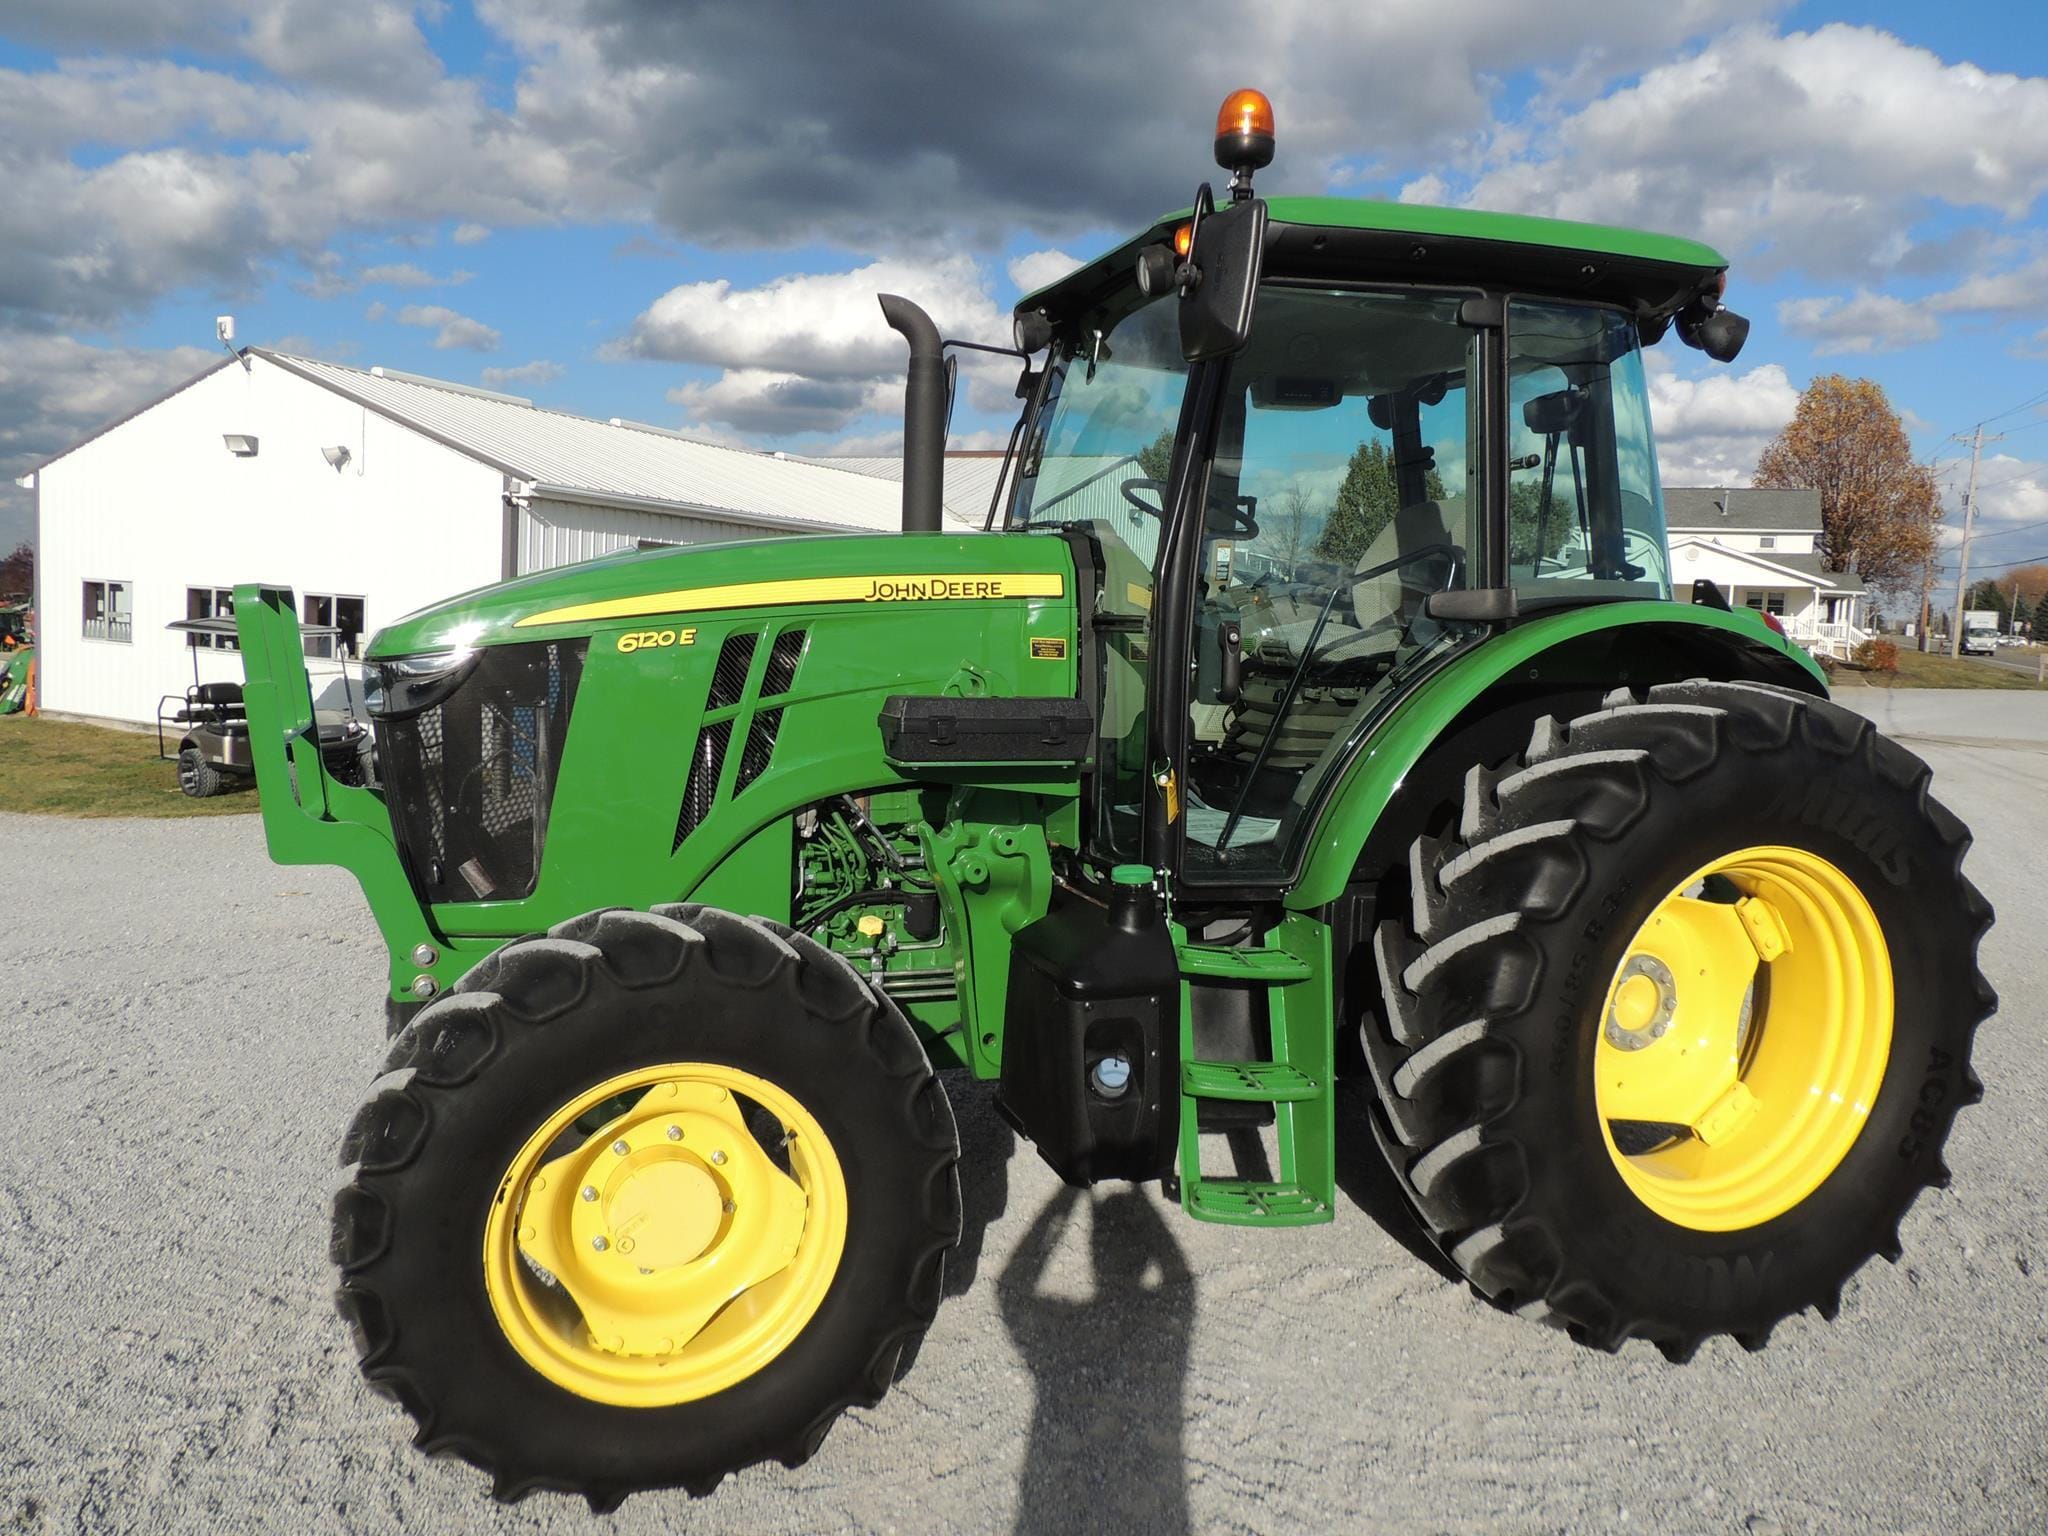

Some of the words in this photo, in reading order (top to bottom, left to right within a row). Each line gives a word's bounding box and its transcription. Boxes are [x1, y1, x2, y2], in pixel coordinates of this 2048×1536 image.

[864, 580, 927, 598] JOHN
[930, 579, 1003, 597] DEERE
[617, 630, 676, 653] 6120
[679, 628, 698, 645] E
[1897, 1045, 1954, 1163] AC85
